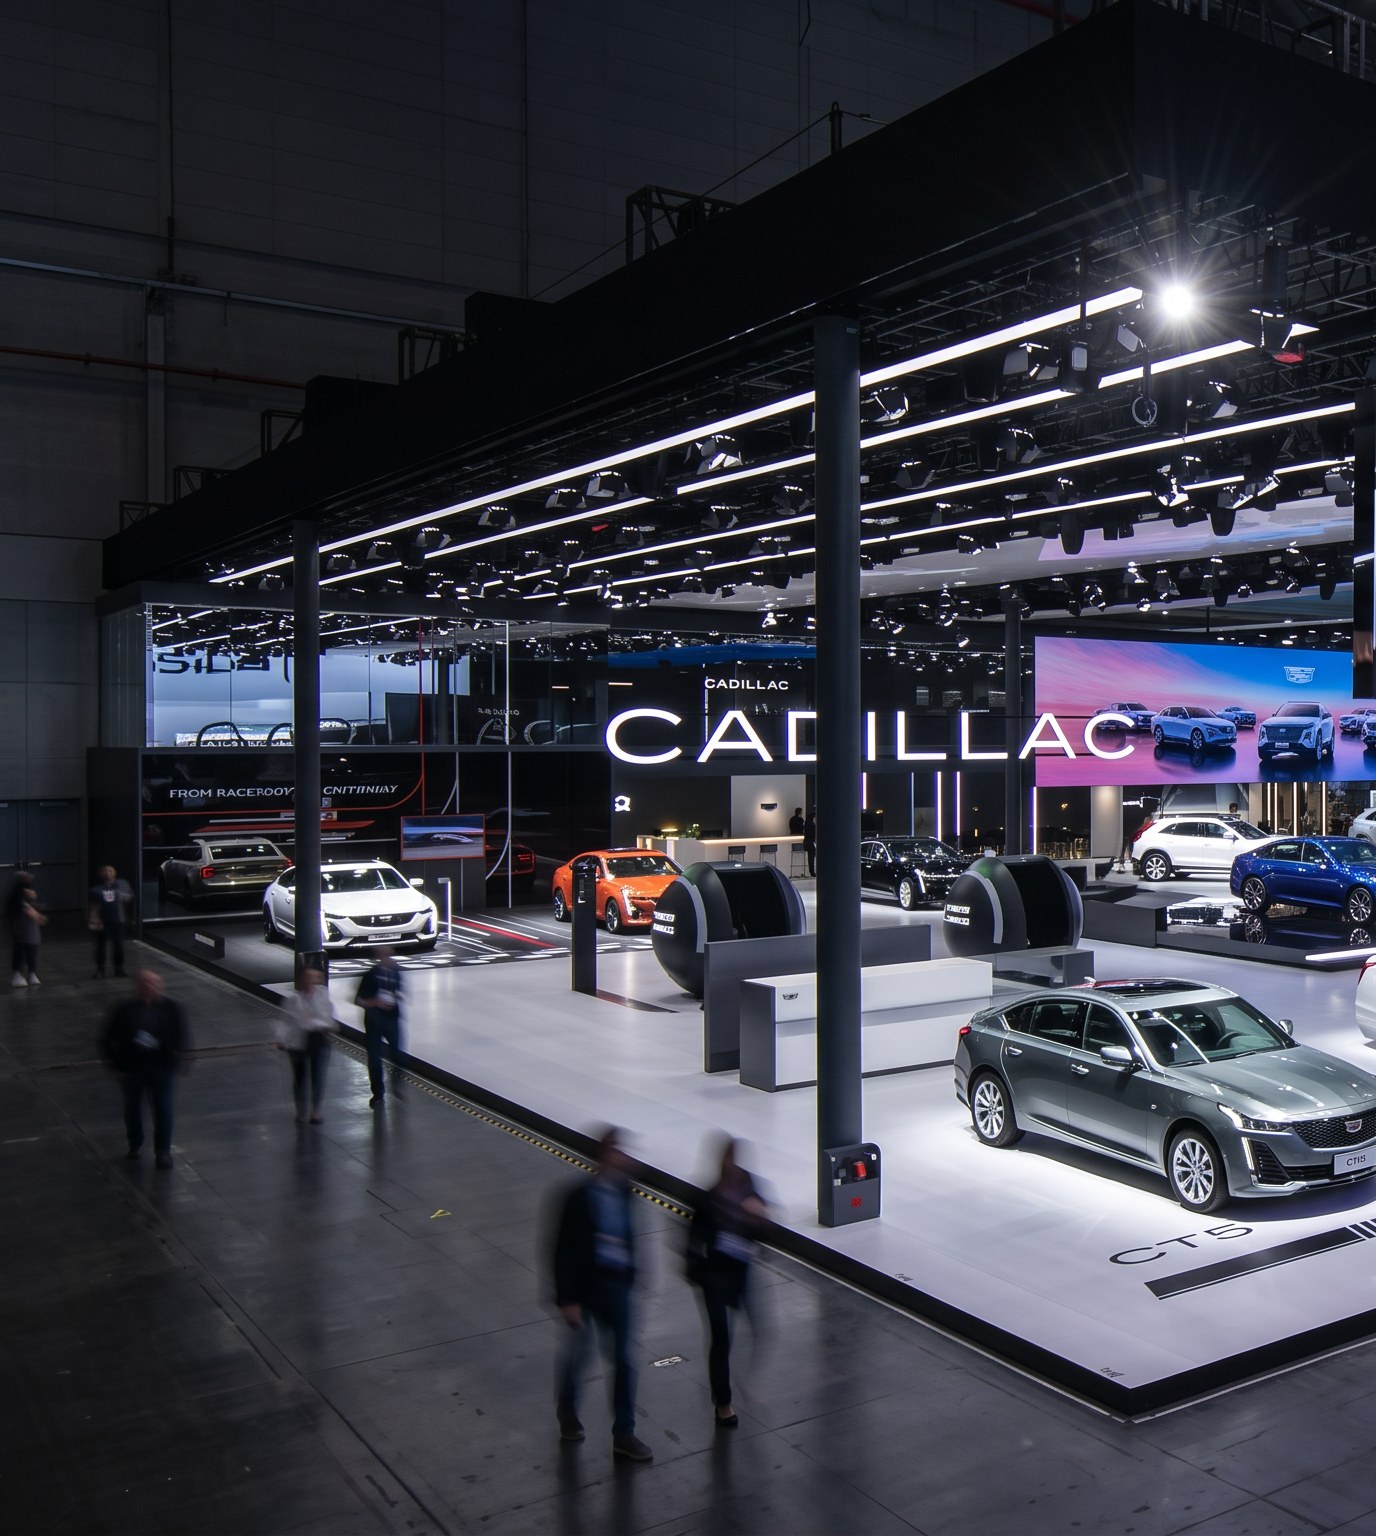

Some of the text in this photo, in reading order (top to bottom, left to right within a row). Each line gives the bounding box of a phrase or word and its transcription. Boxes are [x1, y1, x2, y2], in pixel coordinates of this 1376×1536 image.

[704, 678, 789, 690] CADILLAC
[169, 788, 212, 798] FROM
[1109, 1223, 1253, 1265] CT5
